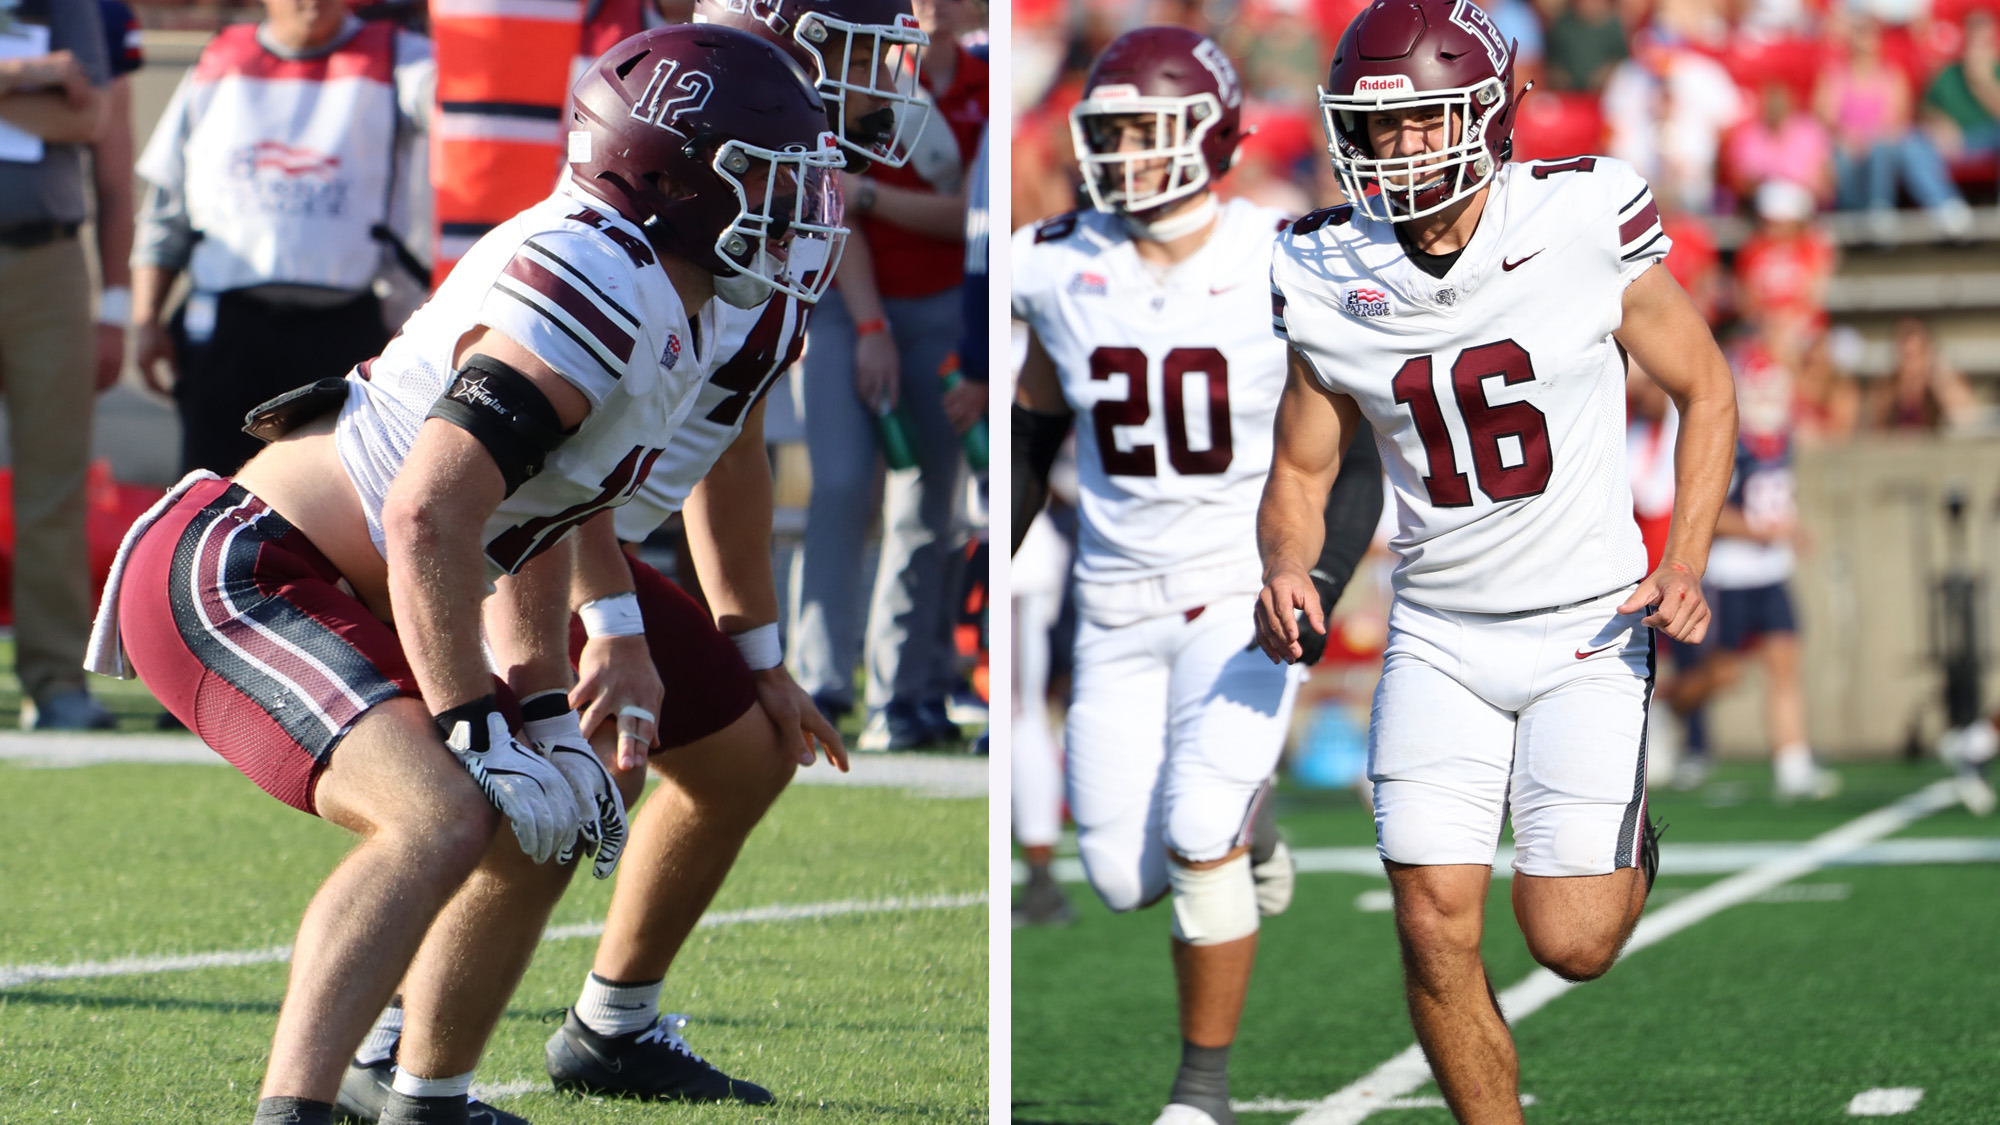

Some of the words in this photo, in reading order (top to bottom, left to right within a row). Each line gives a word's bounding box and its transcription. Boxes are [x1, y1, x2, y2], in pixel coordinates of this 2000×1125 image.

[630, 58, 715, 139] 12
[1359, 78, 1404, 90] Riddell
[1345, 301, 1390, 311] PATRIOT
[1353, 308, 1391, 318] EAGUE
[465, 384, 509, 415] Douglas
[1089, 346, 1234, 477] 20
[1392, 338, 1553, 508] 16
